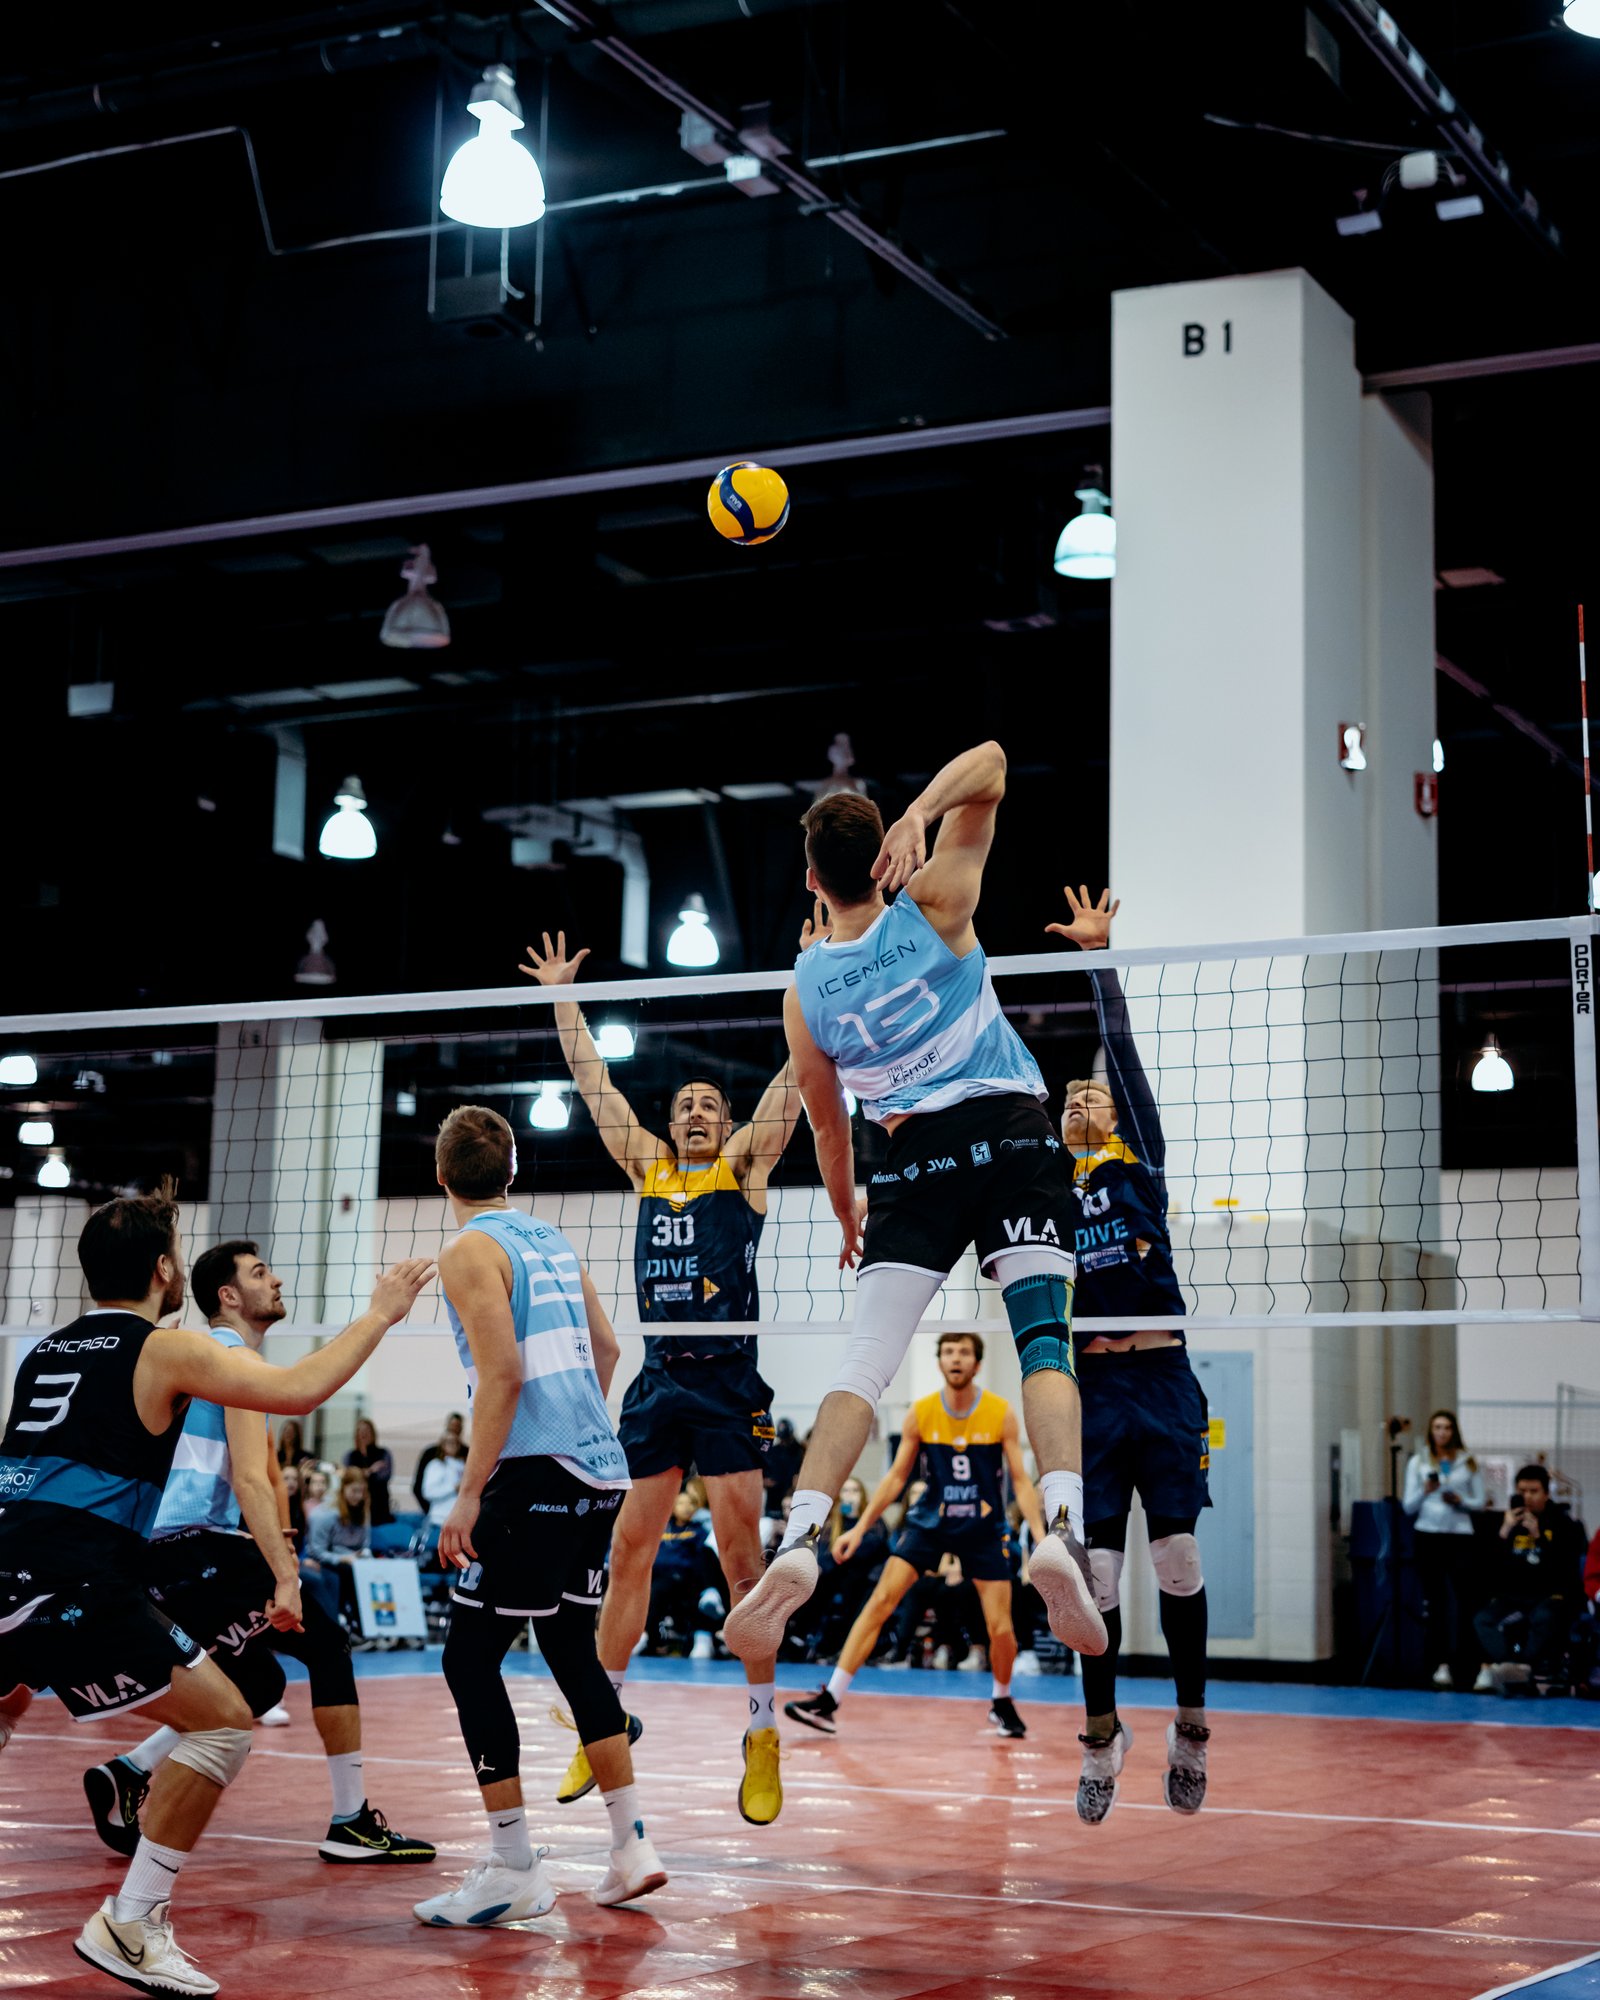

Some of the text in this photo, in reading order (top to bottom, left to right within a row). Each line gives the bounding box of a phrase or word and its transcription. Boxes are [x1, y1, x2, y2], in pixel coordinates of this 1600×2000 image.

[817, 939, 917, 999] ICEMEN
[837, 978, 941, 1054] 13
[926, 1156, 957, 1173] JVA
[651, 1213, 695, 1247] 30
[1002, 1216, 1061, 1246] VLA
[1074, 1217, 1129, 1251] DIVE
[646, 1255, 699, 1278] DIVE
[36, 1335, 121, 1353] CHICAGO
[15, 1372, 82, 1432] 3
[951, 1454, 971, 1481] 9
[943, 1484, 979, 1501] DIVE
[216, 1610, 268, 1648] VLA
[71, 1673, 148, 1708] VLA
